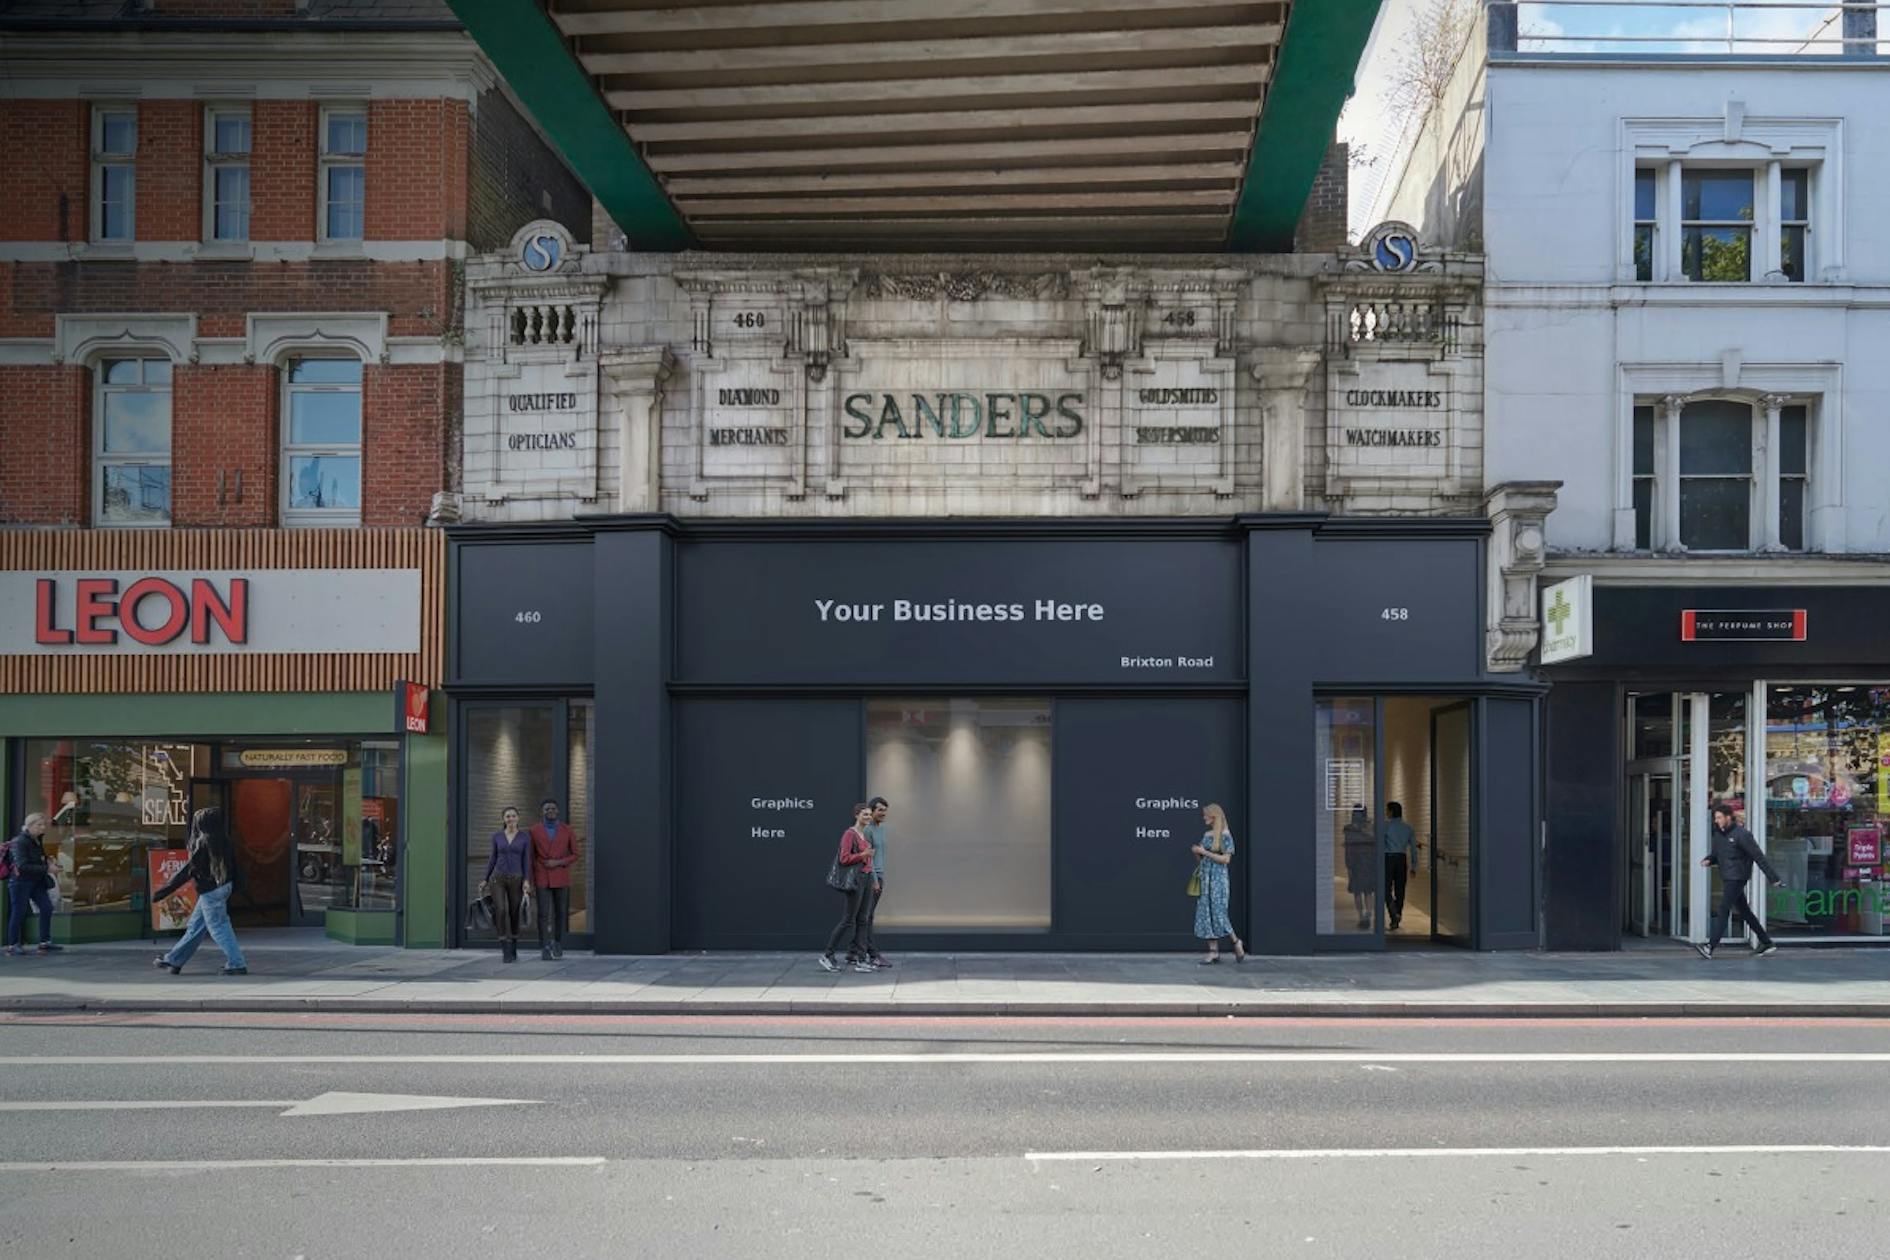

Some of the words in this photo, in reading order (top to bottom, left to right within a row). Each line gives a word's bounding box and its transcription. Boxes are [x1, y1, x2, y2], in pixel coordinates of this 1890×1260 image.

[531, 235, 552, 270] S
[1383, 234, 1406, 270] S
[733, 312, 765, 328] 460
[1162, 311, 1195, 327] 458
[509, 393, 577, 411] QUALIFIED
[719, 388, 780, 406] DIAMOND
[1139, 387, 1218, 404] GOLDSMITHS
[1346, 389, 1441, 407] CLOCKMAKERS
[844, 393, 1083, 439] SANDERS
[508, 432, 577, 450] OPTICIANS
[710, 428, 789, 446] MERCHANTS
[1346, 429, 1441, 447] WATCHMAKERS
[35, 576, 249, 646] LEON
[515, 611, 541, 623] 460
[815, 600, 884, 622] Your
[893, 599, 1025, 622] Business
[1035, 599, 1105, 622] Here
[1381, 608, 1409, 620] 458
[1696, 622, 1714, 630] THE
[1719, 622, 1761, 630] PERFUME
[1767, 622, 1793, 630] SHOP
[1121, 656, 1173, 668] Brixton
[1178, 656, 1214, 668] Road
[406, 716, 426, 732] LEON
[245, 753, 293, 762] NATURALLY
[296, 753, 315, 762] FAST
[318, 753, 345, 761] FOOD
[144, 798, 189, 825] SEATS
[751, 796, 814, 810] Graphics
[1135, 796, 1199, 810] Graphics
[751, 827, 786, 839] Here
[1135, 827, 1171, 839] Here
